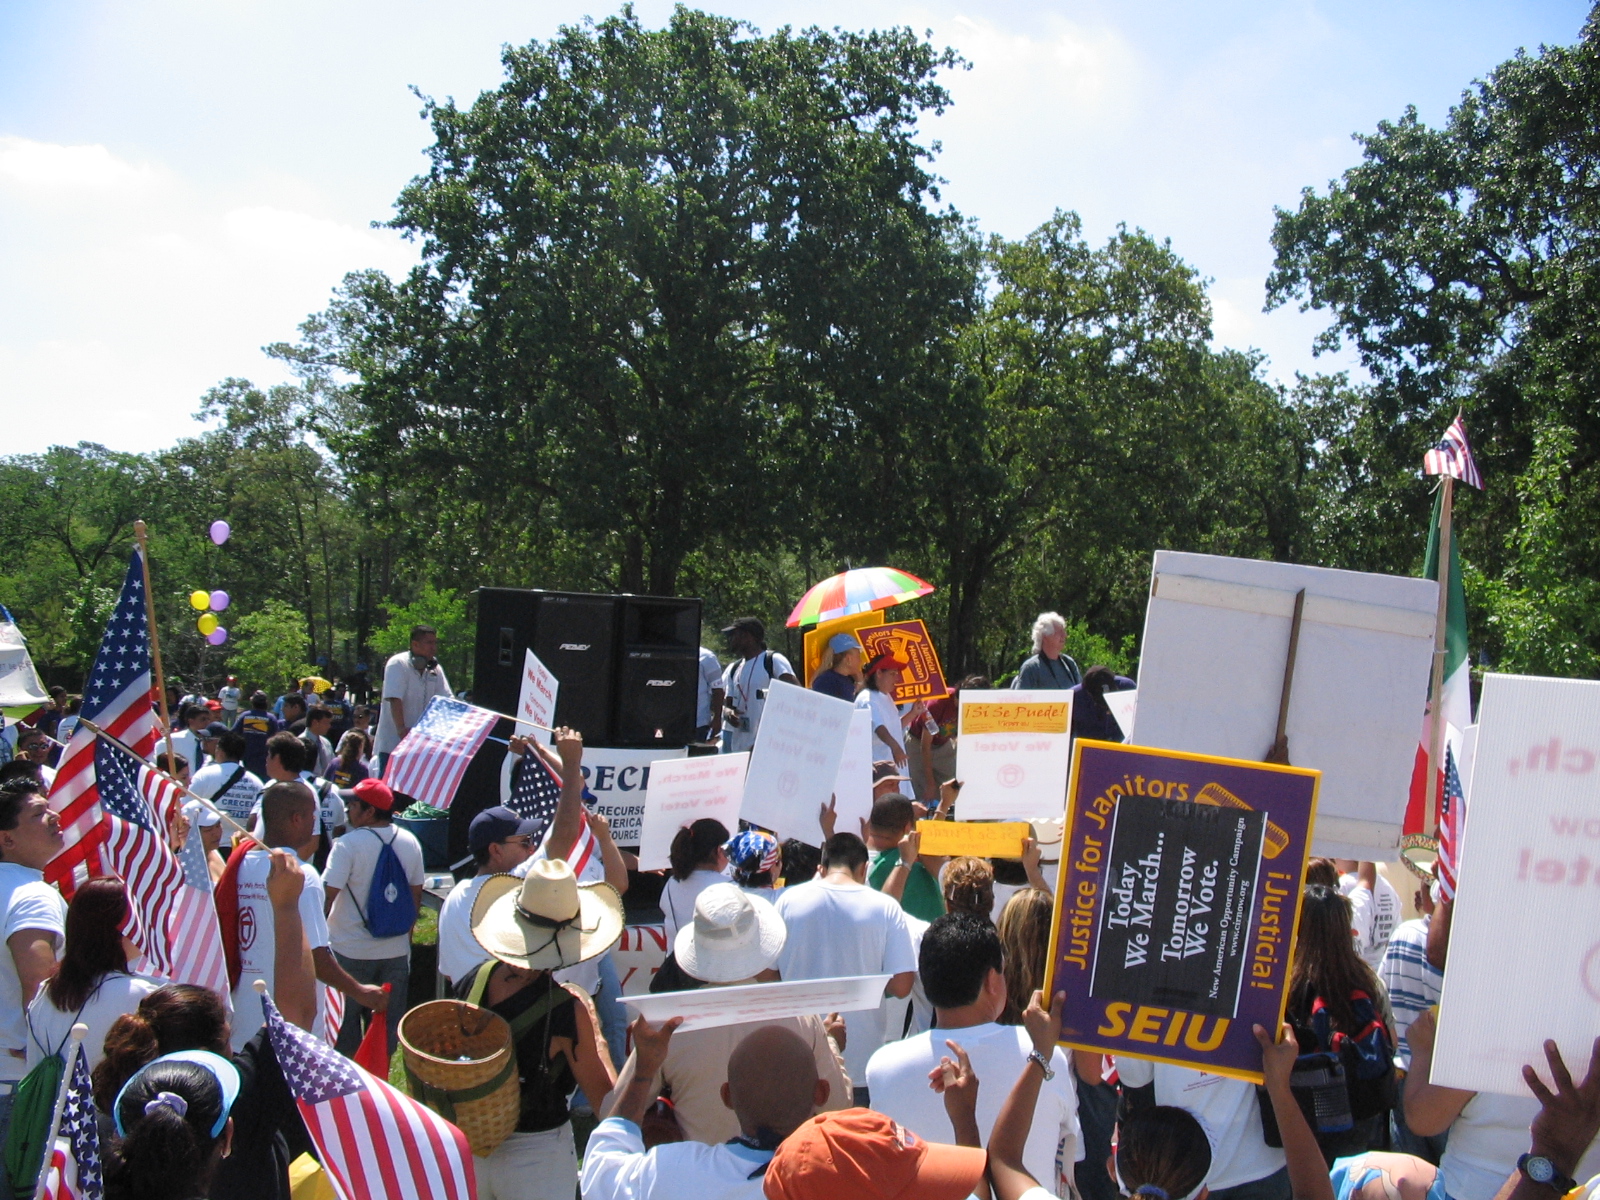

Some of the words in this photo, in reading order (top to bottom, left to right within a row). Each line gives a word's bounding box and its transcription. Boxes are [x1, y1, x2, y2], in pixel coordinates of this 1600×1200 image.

[527, 666, 536, 684] We
[908, 644, 924, 679] Houston
[524, 701, 534, 718] We
[895, 683, 932, 698] SEIU
[992, 706, 1010, 718] Se
[1013, 704, 1067, 721] Puede!
[1085, 774, 1189, 830] Janitors
[609, 829, 639, 840] OURCE
[1075, 835, 1102, 872] for
[1229, 817, 1247, 867] Campaign
[1107, 862, 1142, 930] Today
[1130, 832, 1165, 929] March...
[1160, 846, 1197, 962] Tomorrow
[1189, 860, 1219, 917] Vote.
[1220, 868, 1239, 928] Opportunity
[1063, 881, 1097, 970] Justice
[1183, 922, 1209, 959] We
[1230, 880, 1250, 957] www.cirnow.org
[1251, 871, 1291, 990] ¡Justicia!
[1124, 933, 1150, 969] We
[1213, 930, 1227, 976] American
[1209, 977, 1220, 999] New
[1097, 1001, 1231, 1052] SEIU
